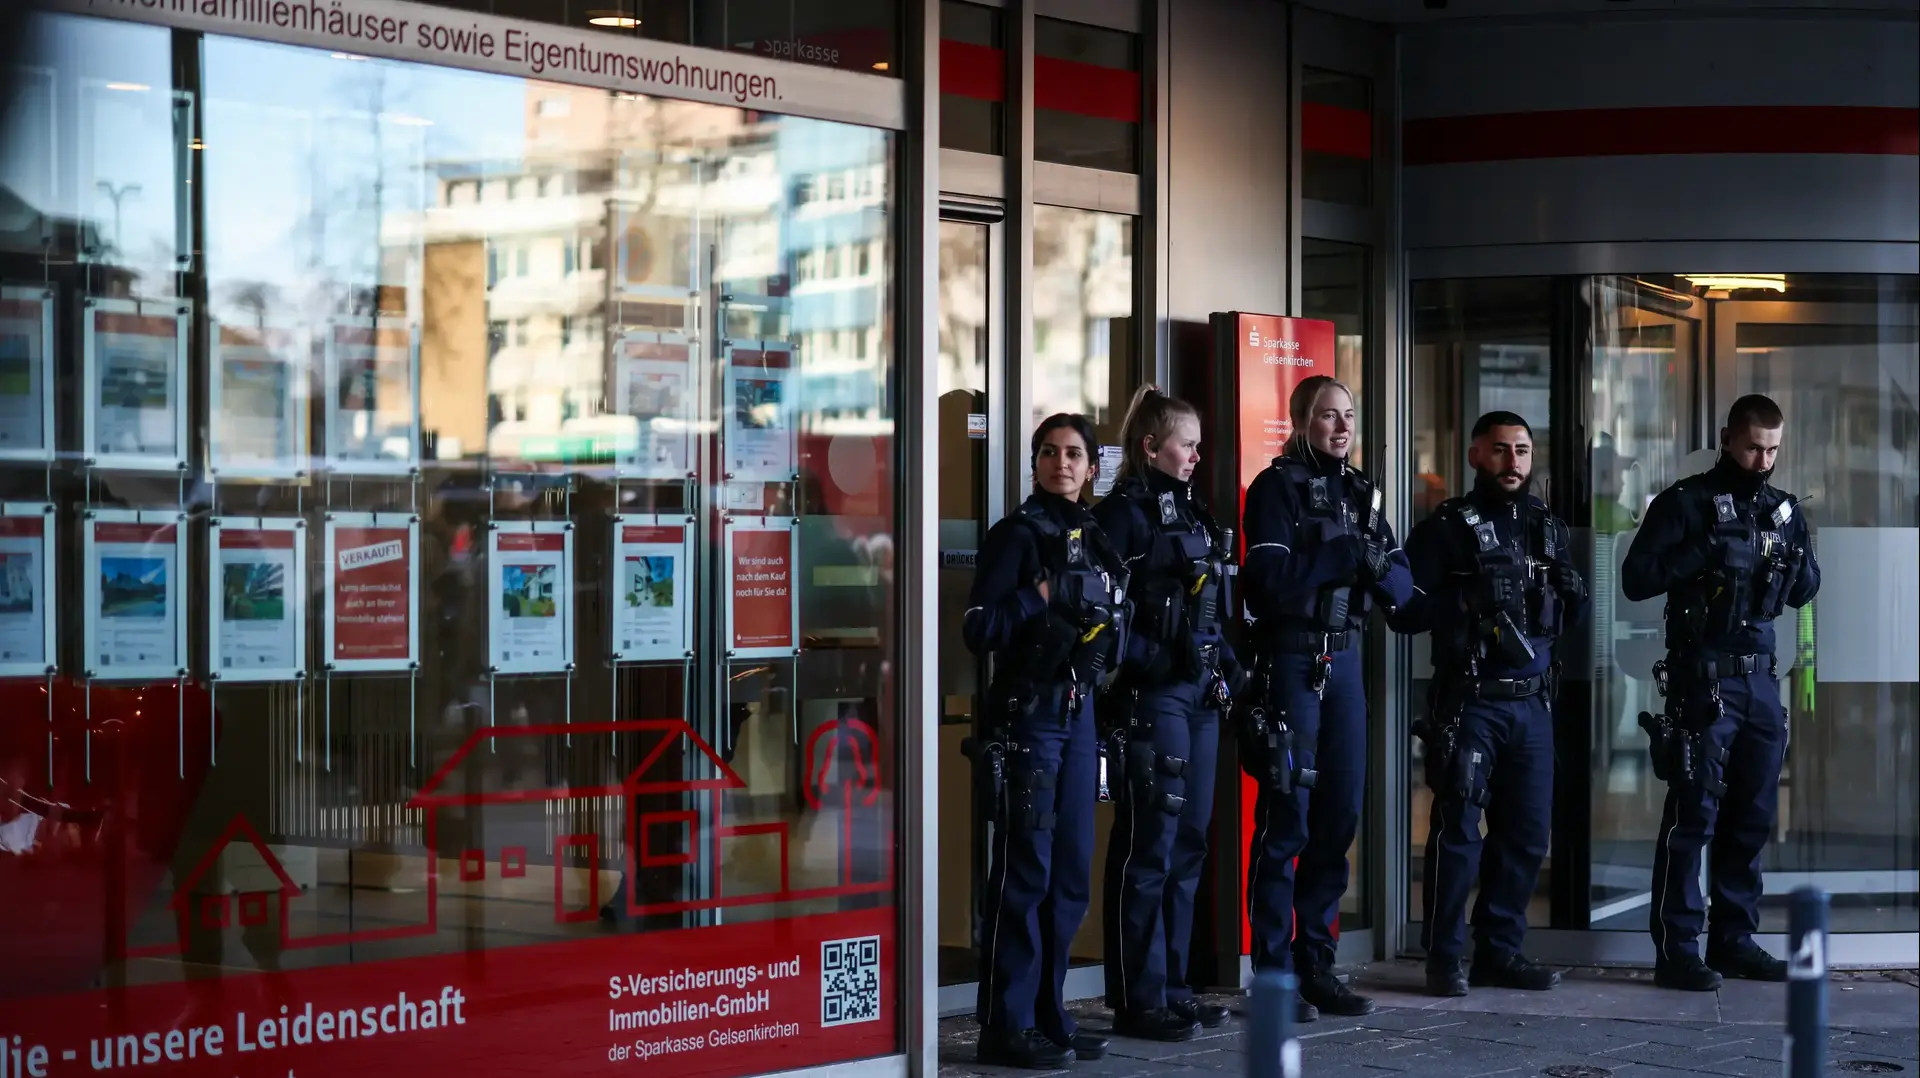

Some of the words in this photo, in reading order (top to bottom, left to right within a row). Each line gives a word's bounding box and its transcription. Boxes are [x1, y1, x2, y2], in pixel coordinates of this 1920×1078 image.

[112, 0, 408, 44] rfamilienhäuser
[417, 23, 495, 58] sowie
[505, 29, 783, 102] Eigentumswohnungen.
[1263, 337, 1300, 350] Sparkasse
[1263, 353, 1314, 367] Gelsenkirchen
[342, 543, 401, 565] VERKAUFT!
[738, 557, 750, 565] Wir
[751, 556, 766, 565] sind
[767, 556, 784, 565] auch
[946, 551, 977, 565] DRÜCKE
[736, 572, 753, 581] nach
[754, 572, 769, 581] dem
[770, 571, 786, 580] Kauf
[736, 587, 753, 597] noch
[753, 587, 763, 596] für
[764, 586, 775, 596] Sie
[776, 587, 787, 596] da!
[608, 965, 763, 999] S-Versicherungs-
[768, 955, 800, 979] und
[608, 989, 770, 1031] Immobilien-GmbH
[90, 1025, 225, 1070] unsere
[237, 985, 466, 1052] Leidenschaft
[608, 1042, 631, 1062] der
[635, 1034, 705, 1060] Sparkasse
[708, 1021, 799, 1047] Gelsenkirchen
